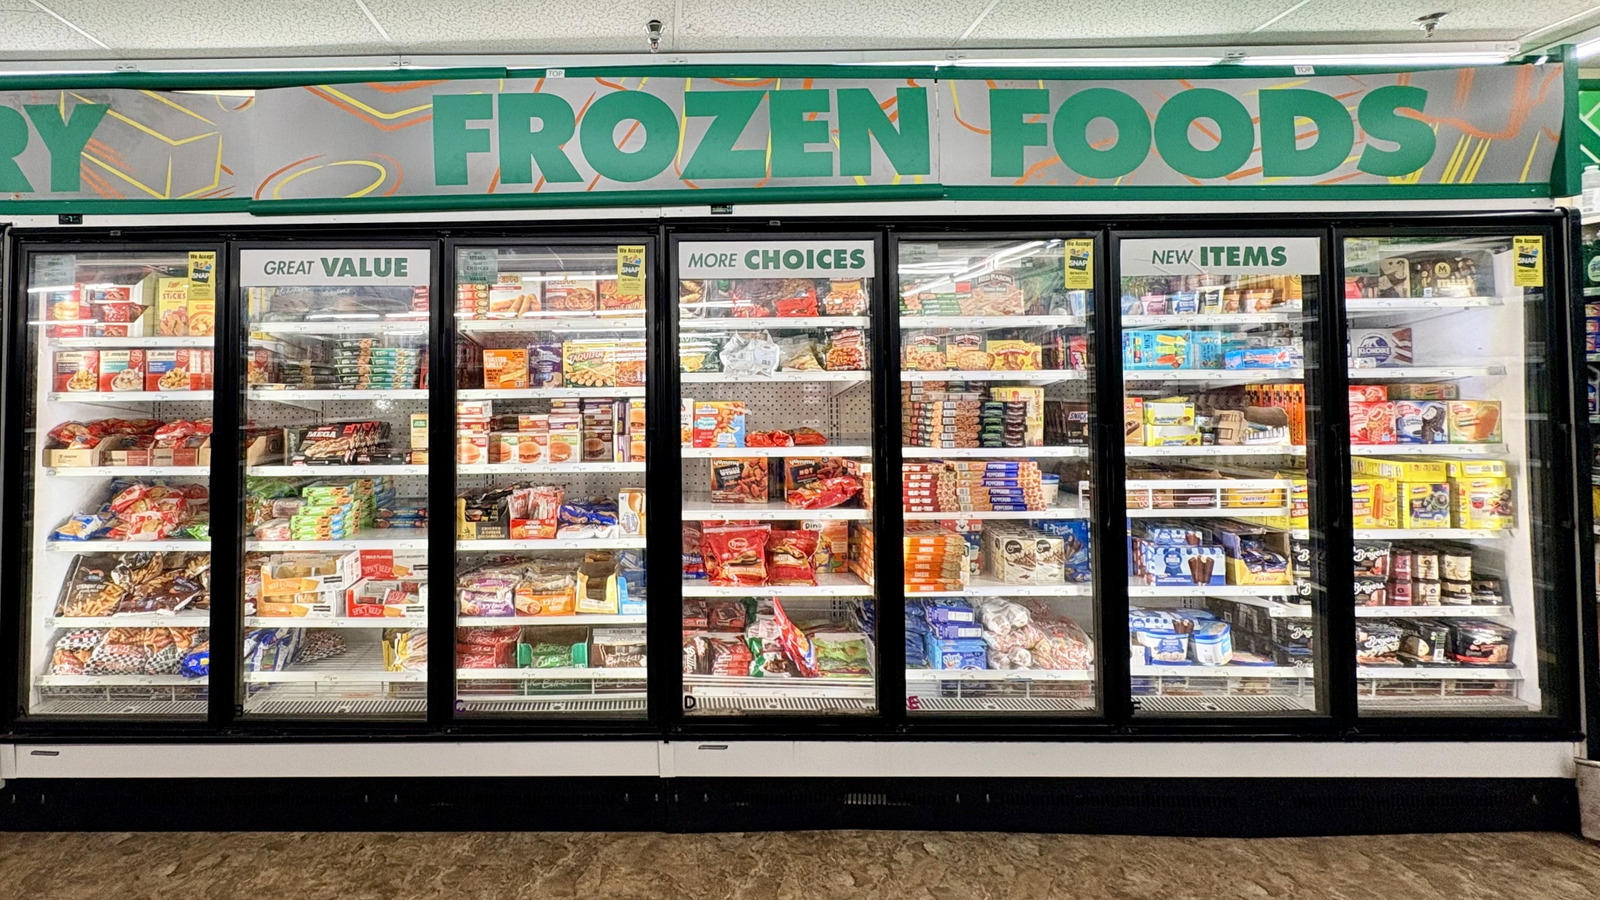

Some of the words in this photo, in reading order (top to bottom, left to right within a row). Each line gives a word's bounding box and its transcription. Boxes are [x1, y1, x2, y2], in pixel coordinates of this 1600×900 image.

[433, 88, 931, 186] FROZEN
[990, 86, 1437, 180] FOODS
[688, 253, 737, 268] MORE
[744, 249, 866, 270] CHOICES
[1069, 259, 1088, 267] SNAP
[1152, 250, 1194, 265] NEW
[1200, 246, 1288, 267] ITEMS
[1518, 256, 1537, 264] SNAP
[264, 260, 315, 275] GREAT
[320, 257, 408, 277] VALUE
[621, 266, 640, 274] SNAP
[1438, 265, 1448, 273] M
[191, 272, 210, 280] SNAP
[1354, 547, 1389, 562] Breyers
[1364, 635, 1400, 648] Breyers
[684, 695, 696, 709] D
[908, 695, 919, 710] E
